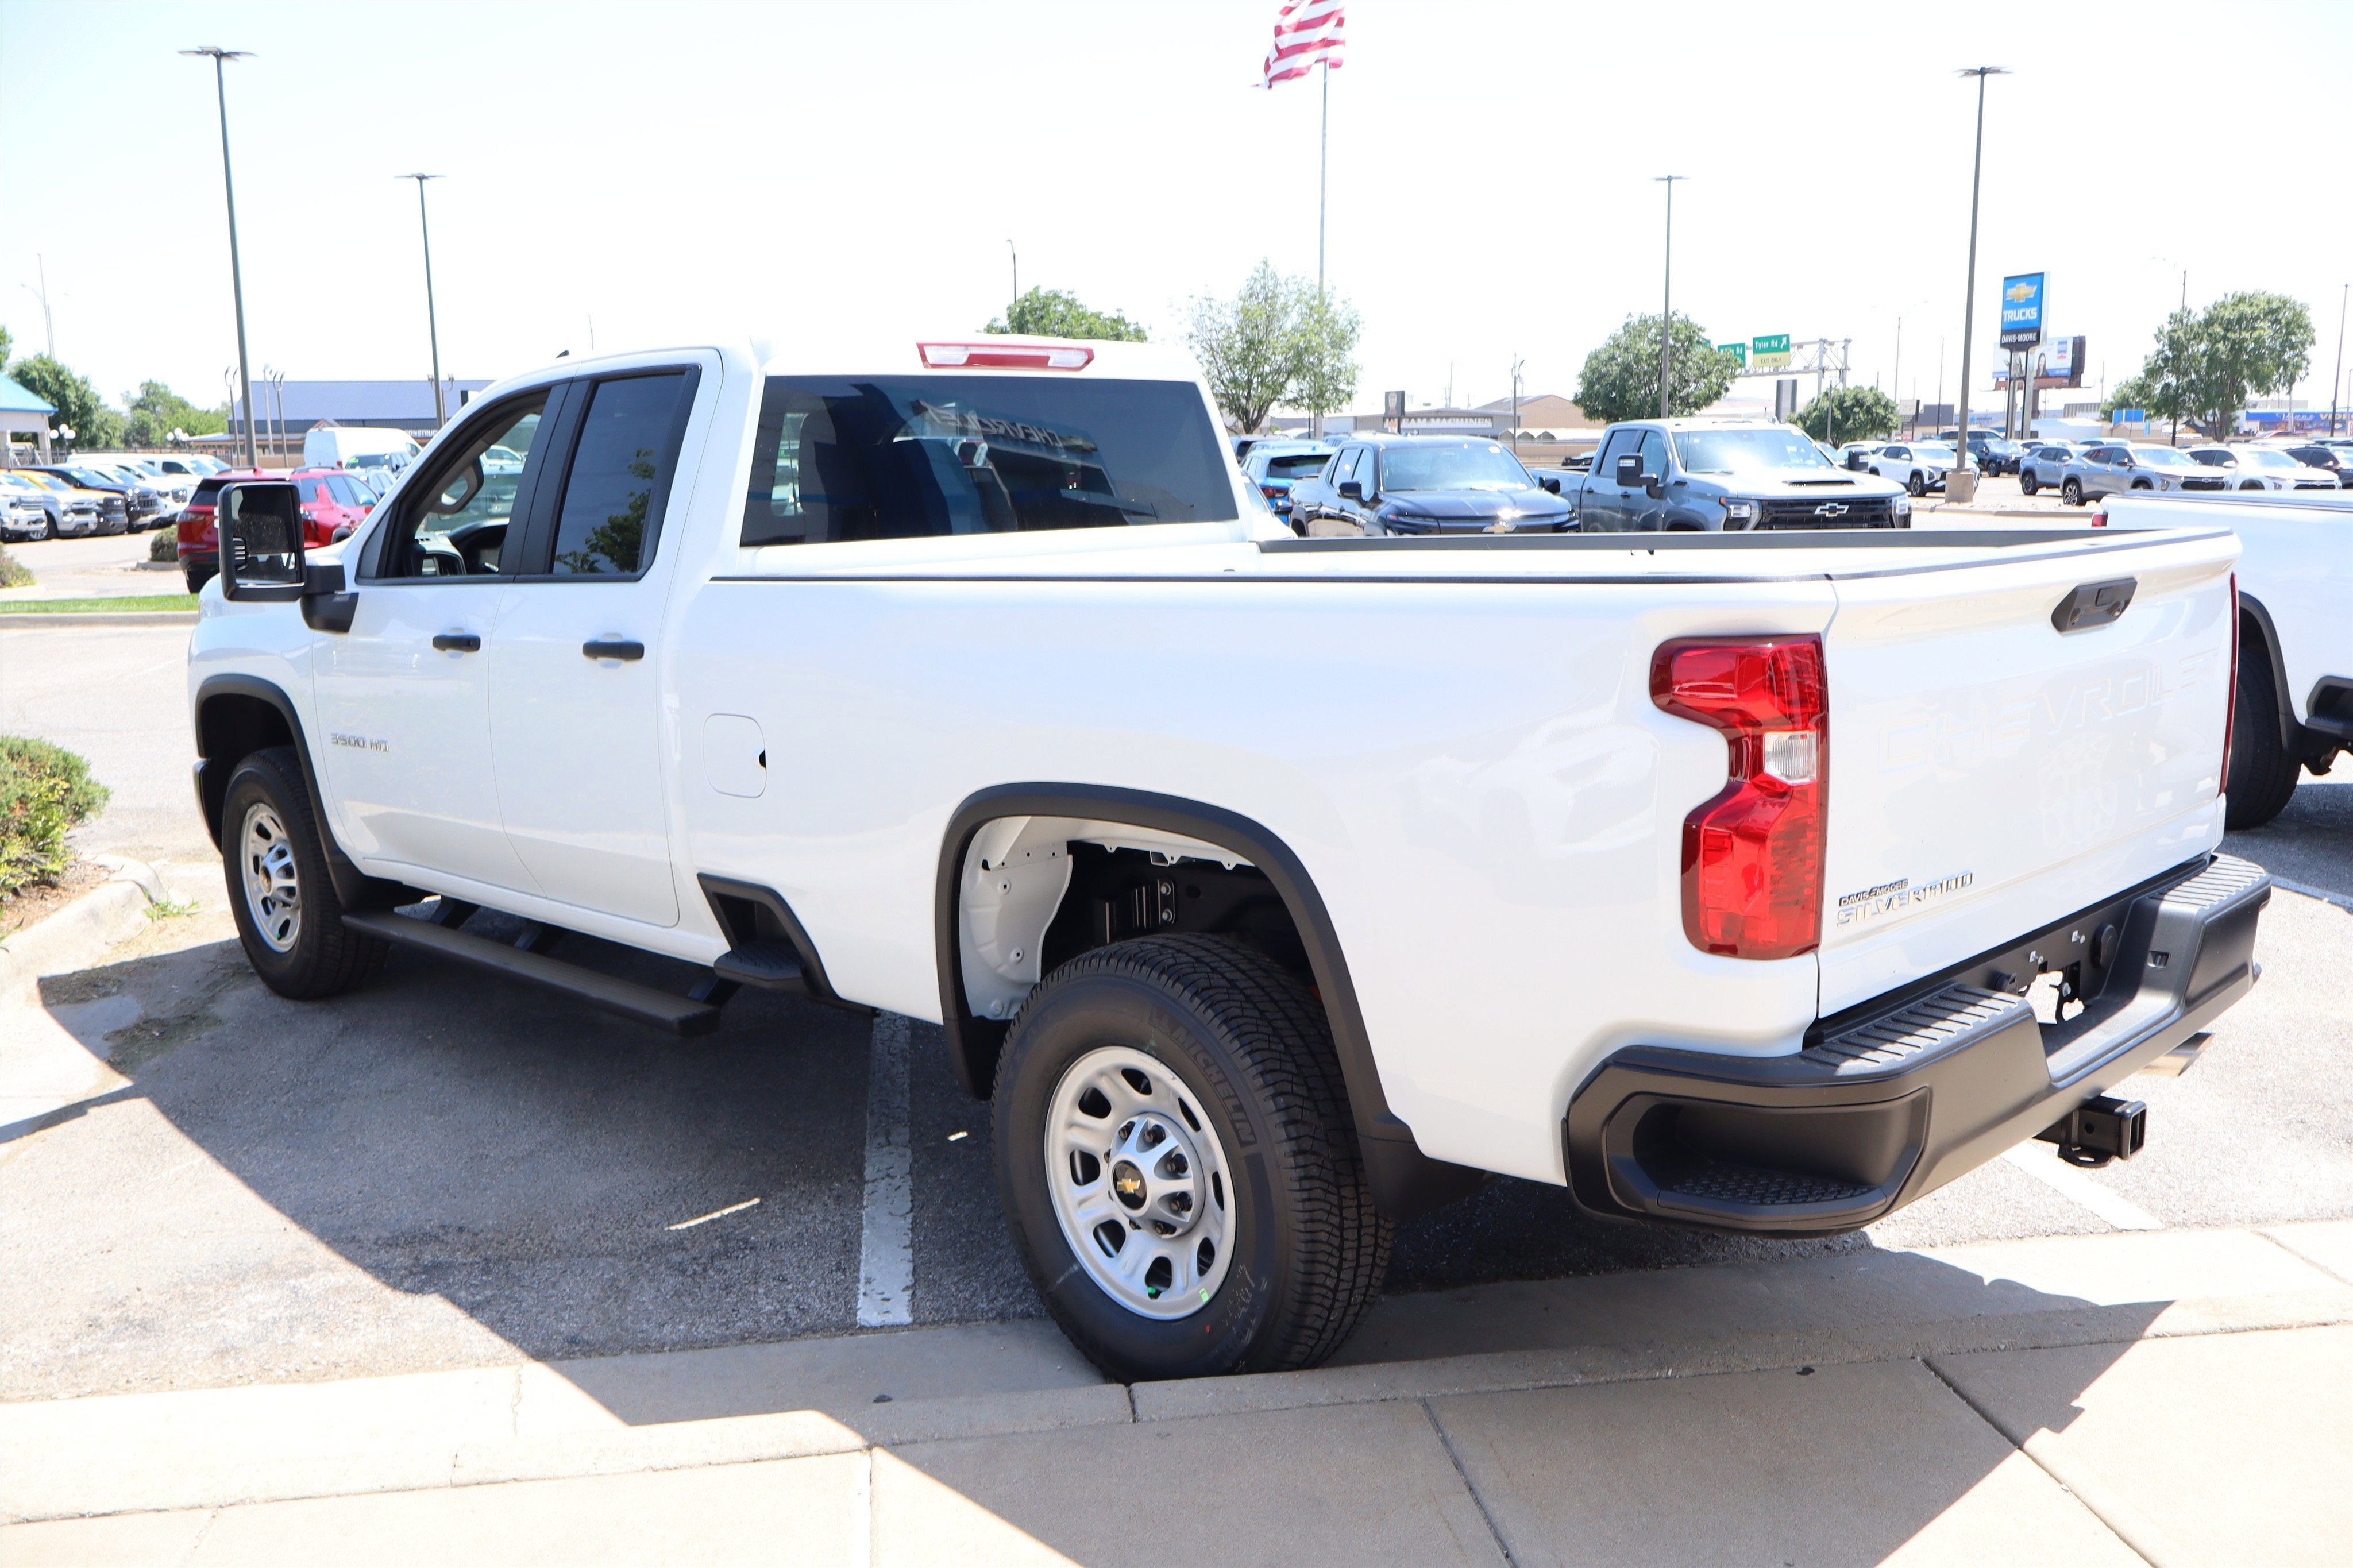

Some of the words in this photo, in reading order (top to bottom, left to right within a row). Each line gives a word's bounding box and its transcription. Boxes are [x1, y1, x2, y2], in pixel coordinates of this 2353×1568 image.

[2003, 307, 2037, 322] TRUCKS
[1736, 347, 1743, 355] Rd
[1755, 340, 1769, 350] Tyler
[1771, 339, 1778, 348] Rd
[1878, 648, 2219, 774] CHEVROLET
[331, 733, 366, 748] 3500
[370, 739, 389, 752] HD
[1837, 871, 1973, 927] SILVERADO
[1170, 1022, 1258, 1148] MICHELIN
